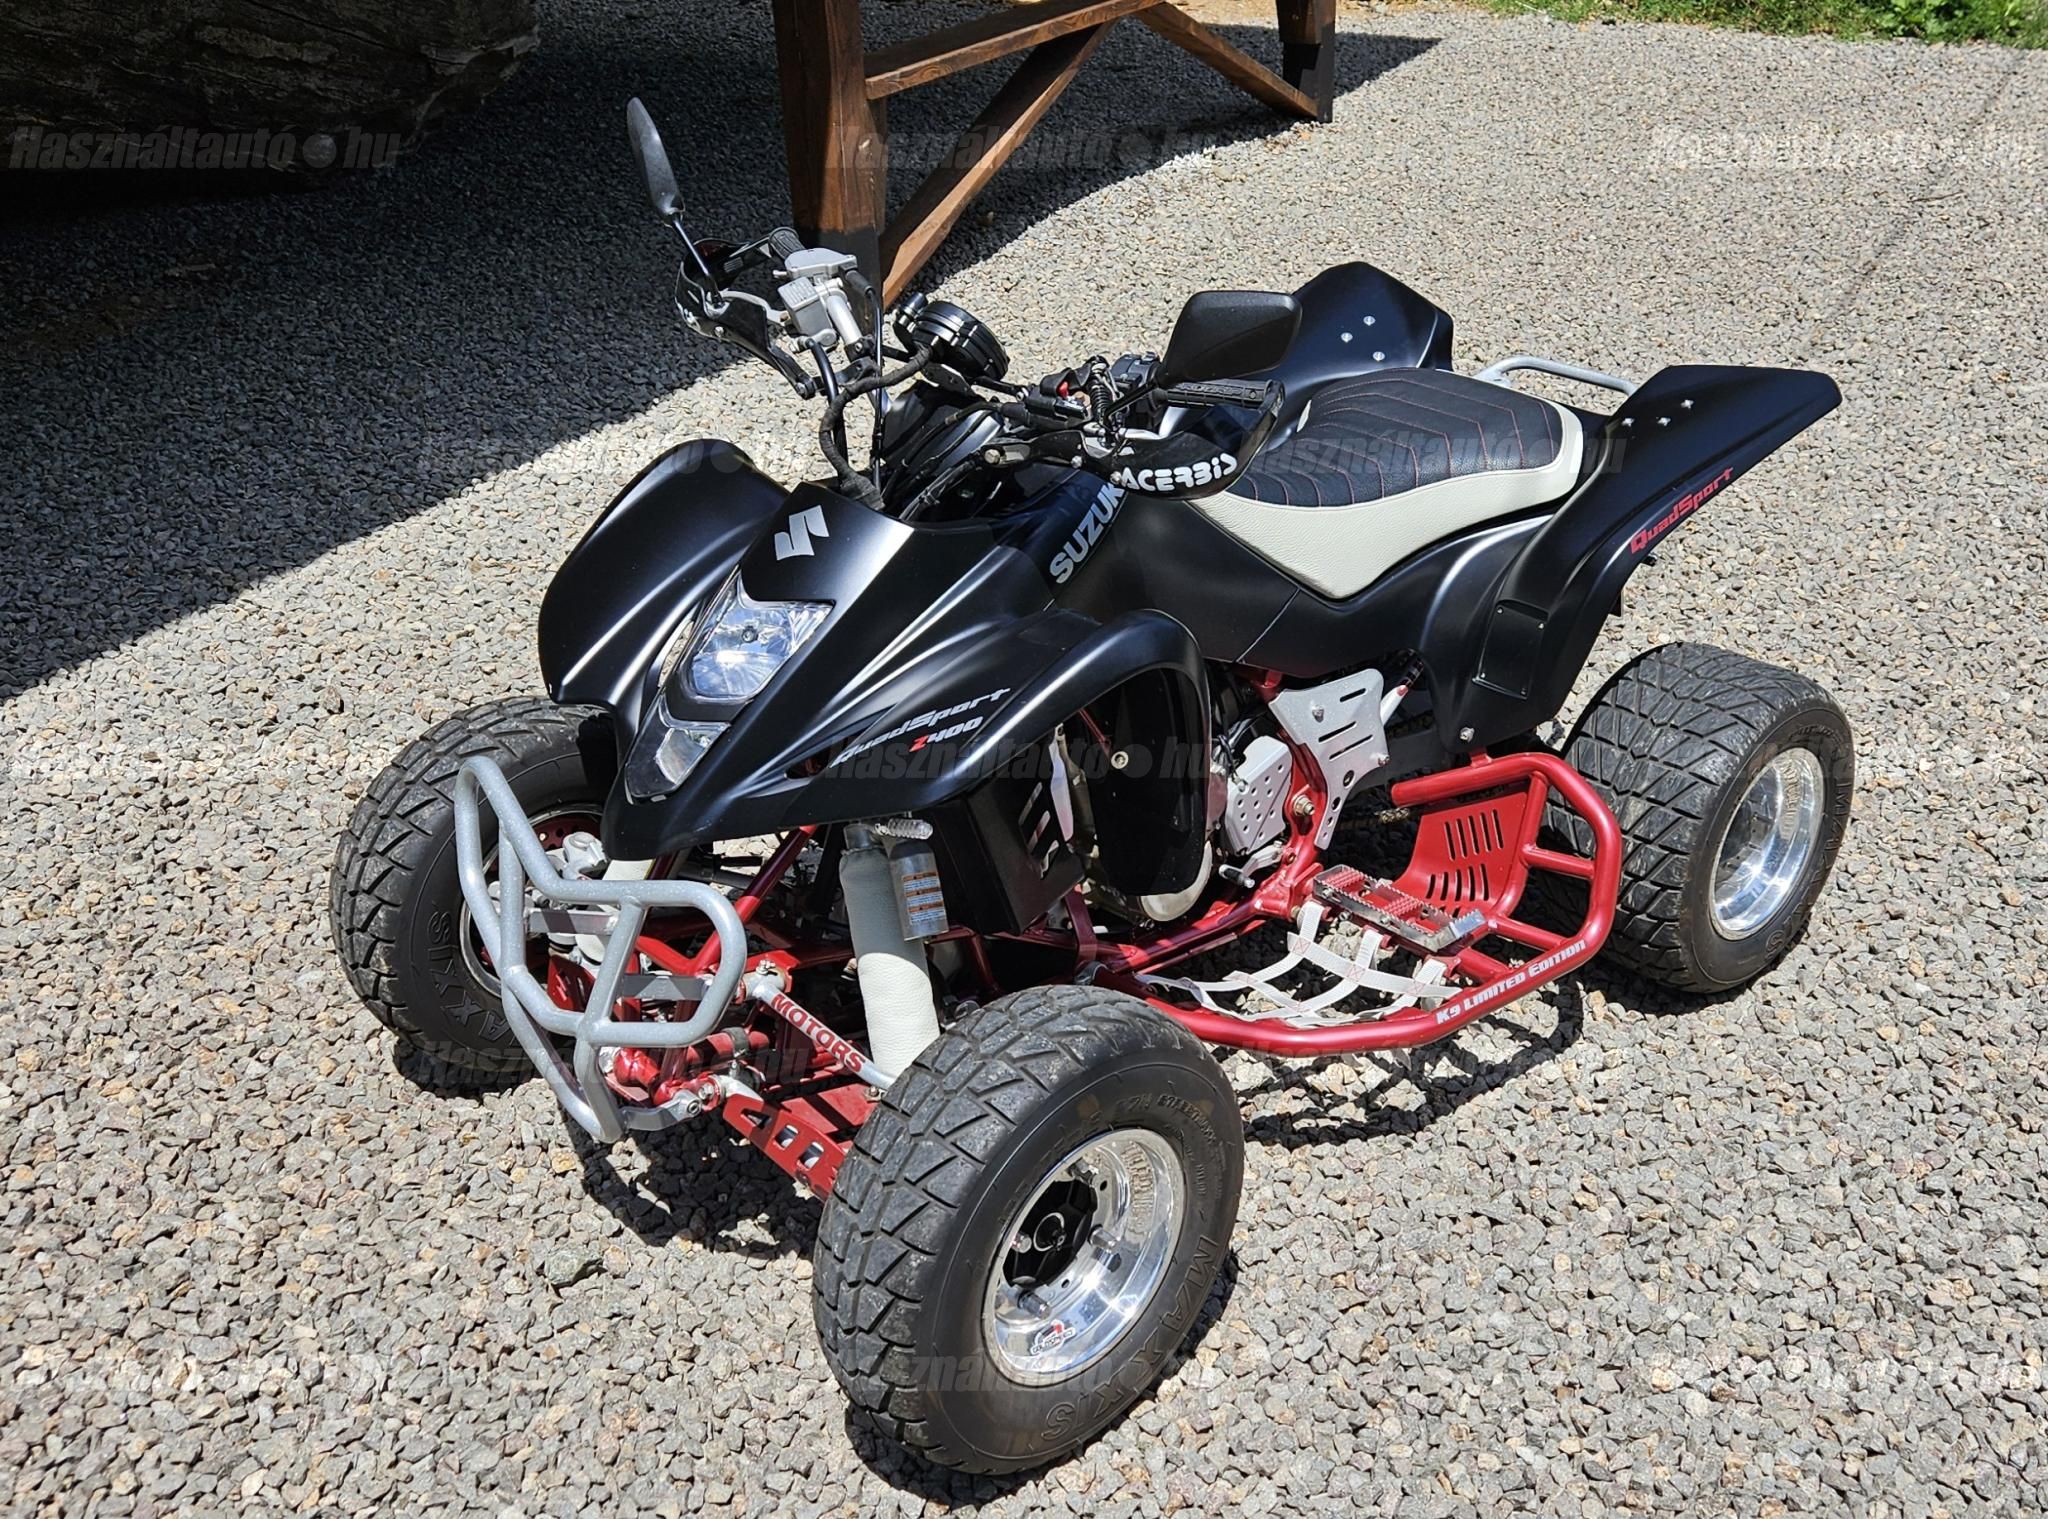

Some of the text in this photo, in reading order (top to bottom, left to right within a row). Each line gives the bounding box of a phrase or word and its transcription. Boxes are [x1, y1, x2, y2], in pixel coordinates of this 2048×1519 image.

[1049, 483, 1125, 584] SUZUK
[1629, 466, 1734, 554] QuadSport
[829, 687, 1011, 769] QuadSport
[908, 716, 984, 753] Z400
[771, 992, 867, 1073] MOTORS
[1435, 1006, 1462, 1025] K9
[1040, 1235, 1220, 1441] MAXXIS
